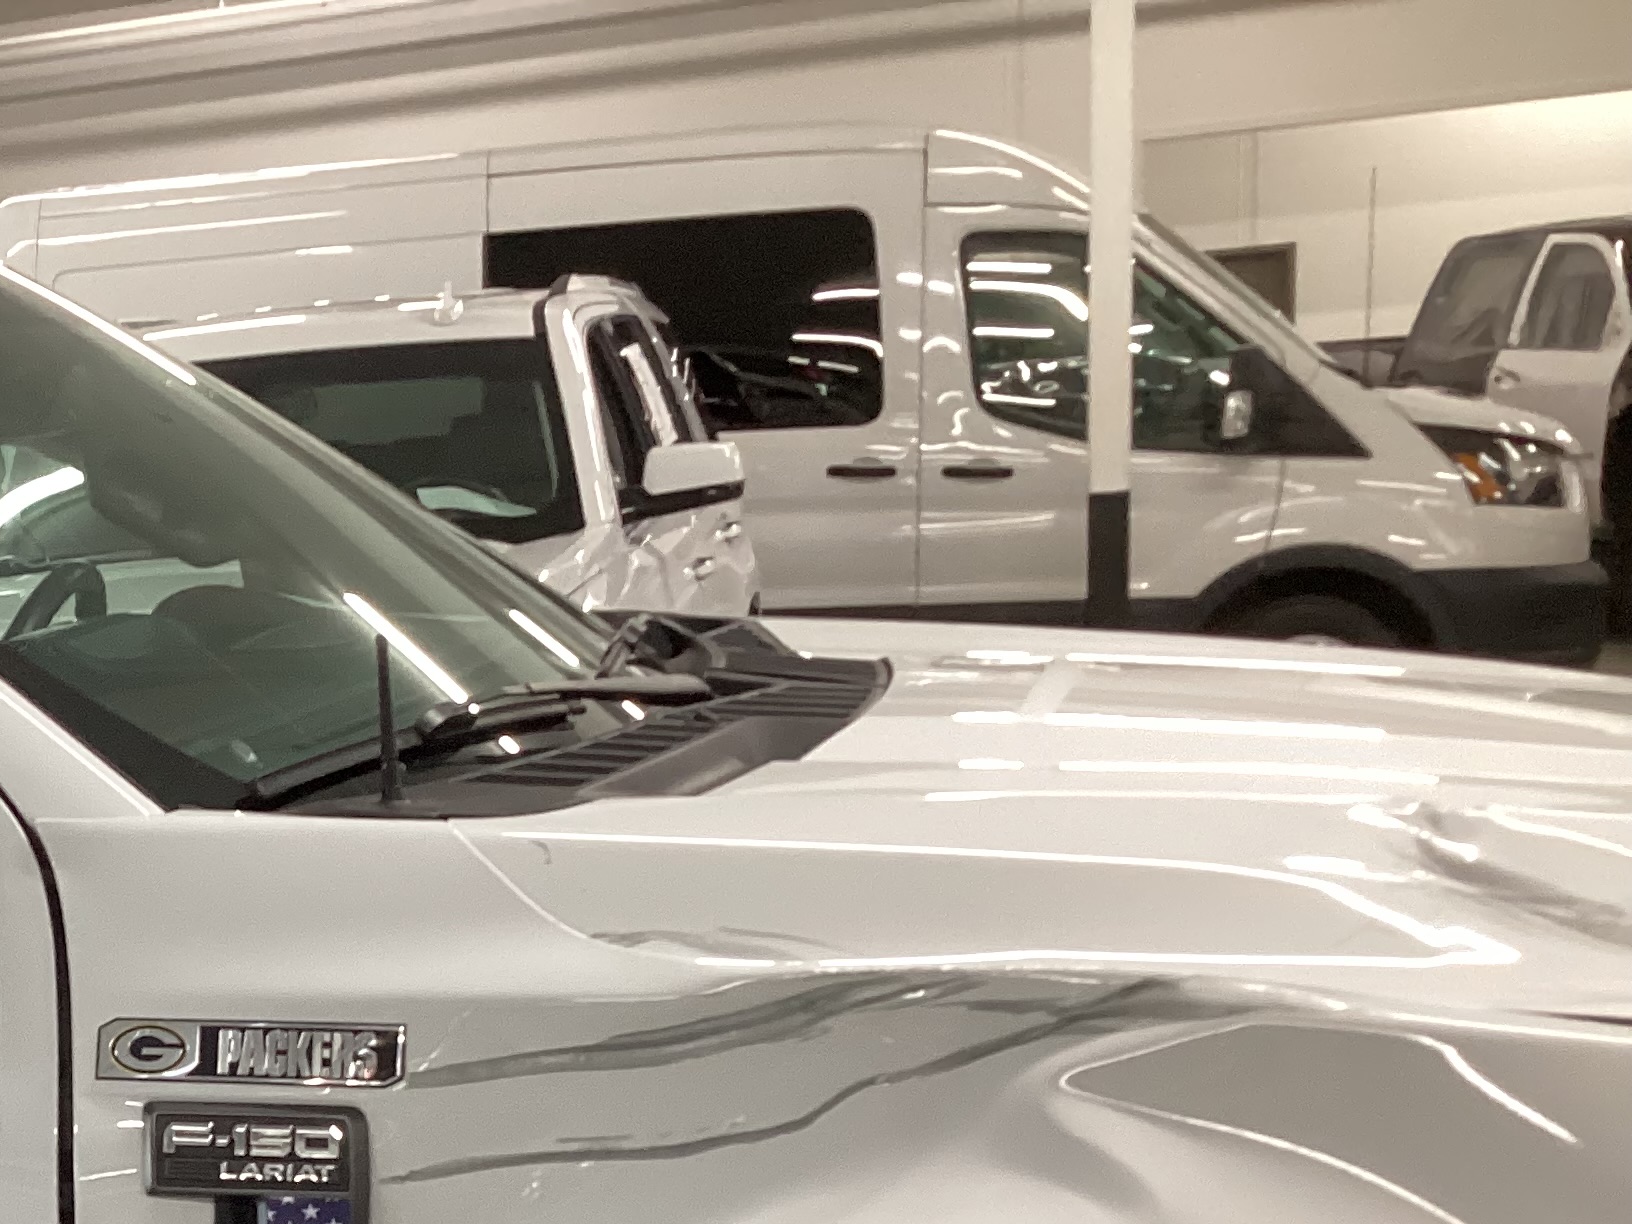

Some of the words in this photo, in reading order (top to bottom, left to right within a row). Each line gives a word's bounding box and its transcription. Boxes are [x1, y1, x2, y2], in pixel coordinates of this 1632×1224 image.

[112, 1026, 186, 1073] G
[217, 1028, 379, 1079] PACKERS
[162, 1120, 344, 1159] F-150
[218, 1162, 337, 1183] LARIAT
